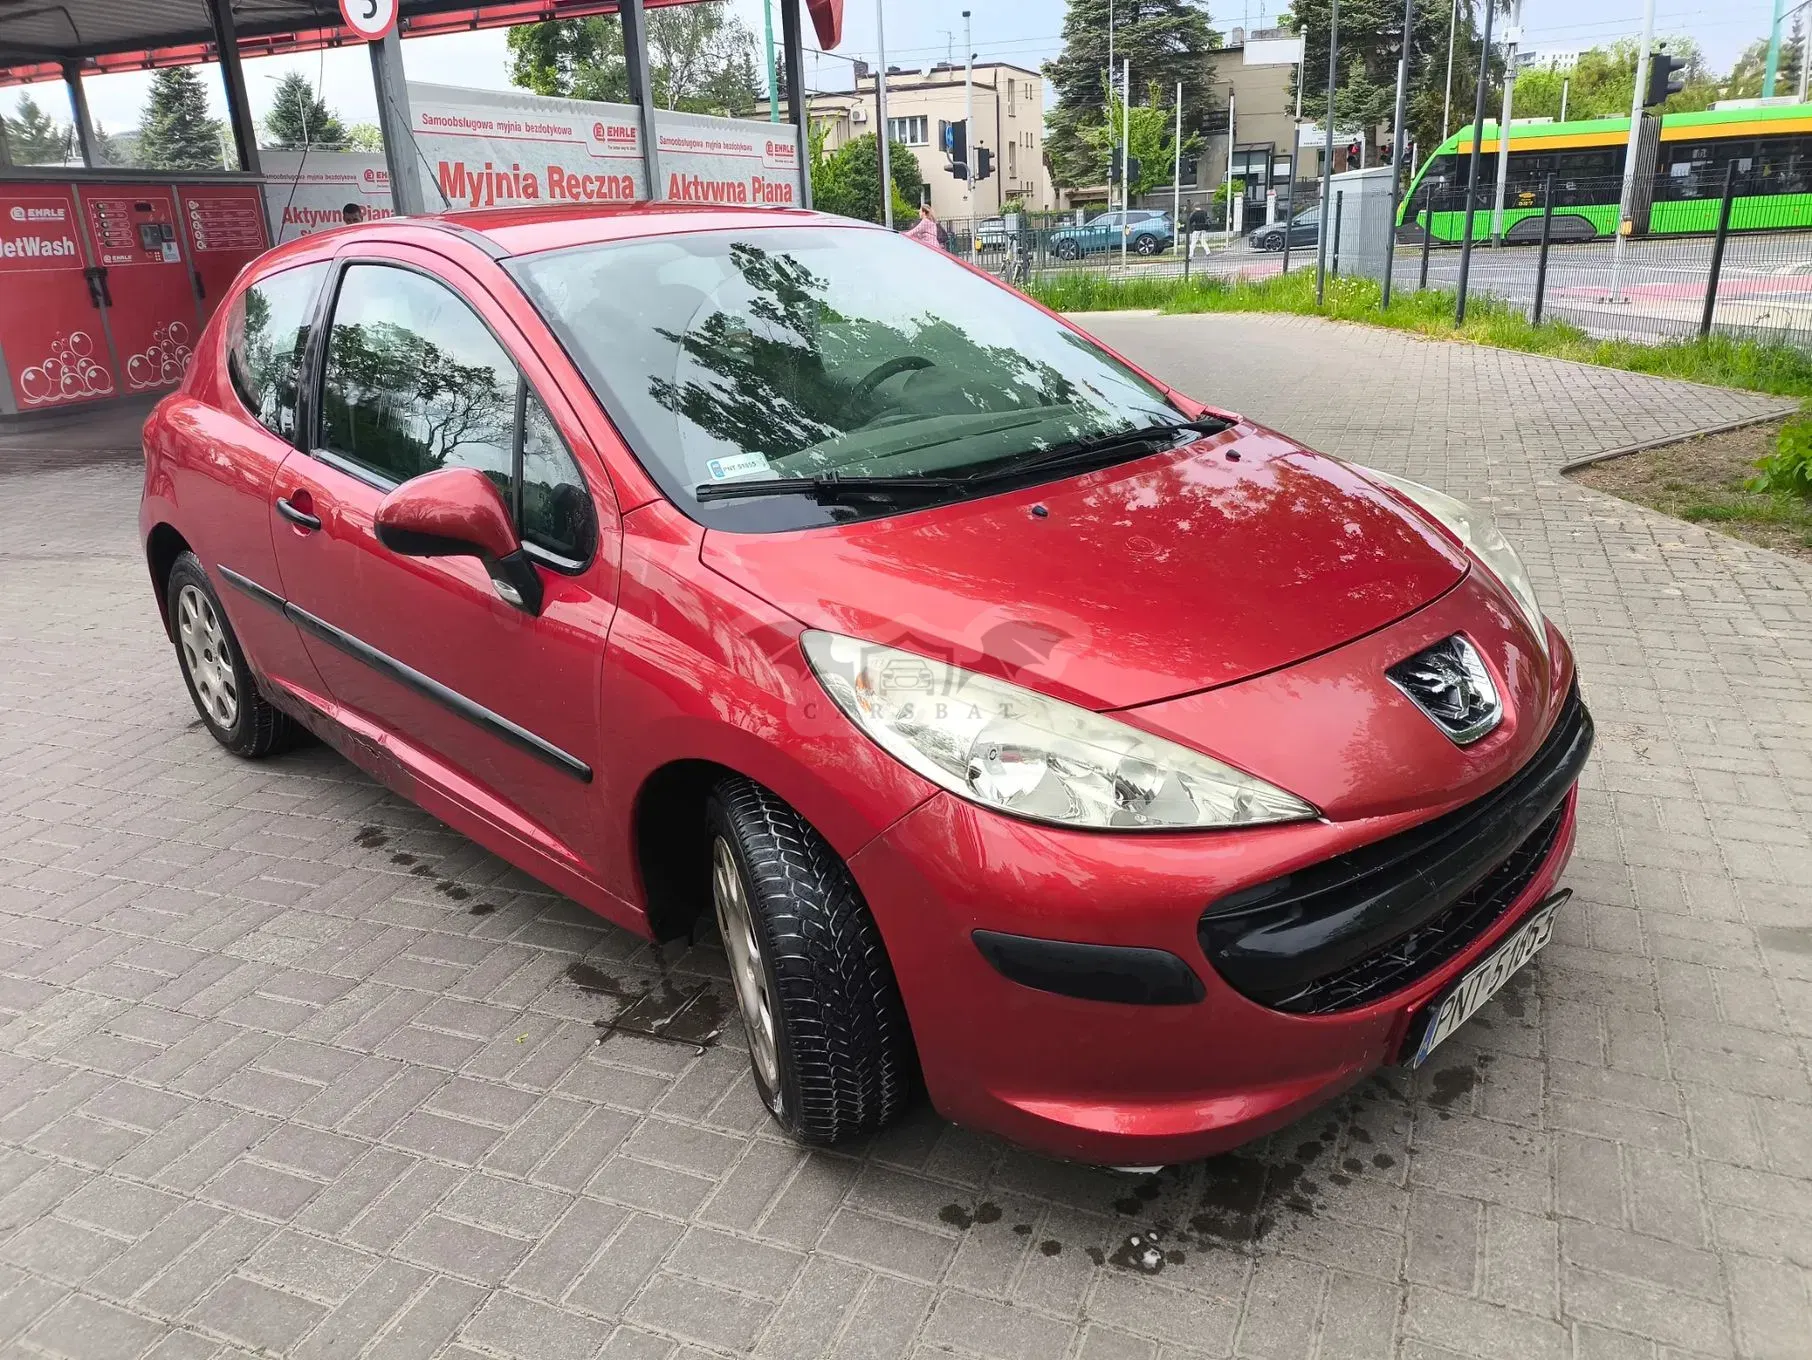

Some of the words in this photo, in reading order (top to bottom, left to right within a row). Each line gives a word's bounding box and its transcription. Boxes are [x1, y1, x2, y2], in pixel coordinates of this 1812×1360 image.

[496, 120, 521, 134] myjnia
[525, 122, 572, 137] bezdotykowa
[607, 126, 636, 138] EHRLE
[774, 143, 794, 153] EHRLE
[438, 161, 539, 208] Myjnia
[547, 165, 634, 201] Ręczna
[668, 173, 747, 201] Aktywna
[751, 175, 793, 202] Piana
[27, 208, 65, 217] EHRLE
[283, 206, 344, 228] Aktywn
[1432, 964, 1491, 1046] PNT
